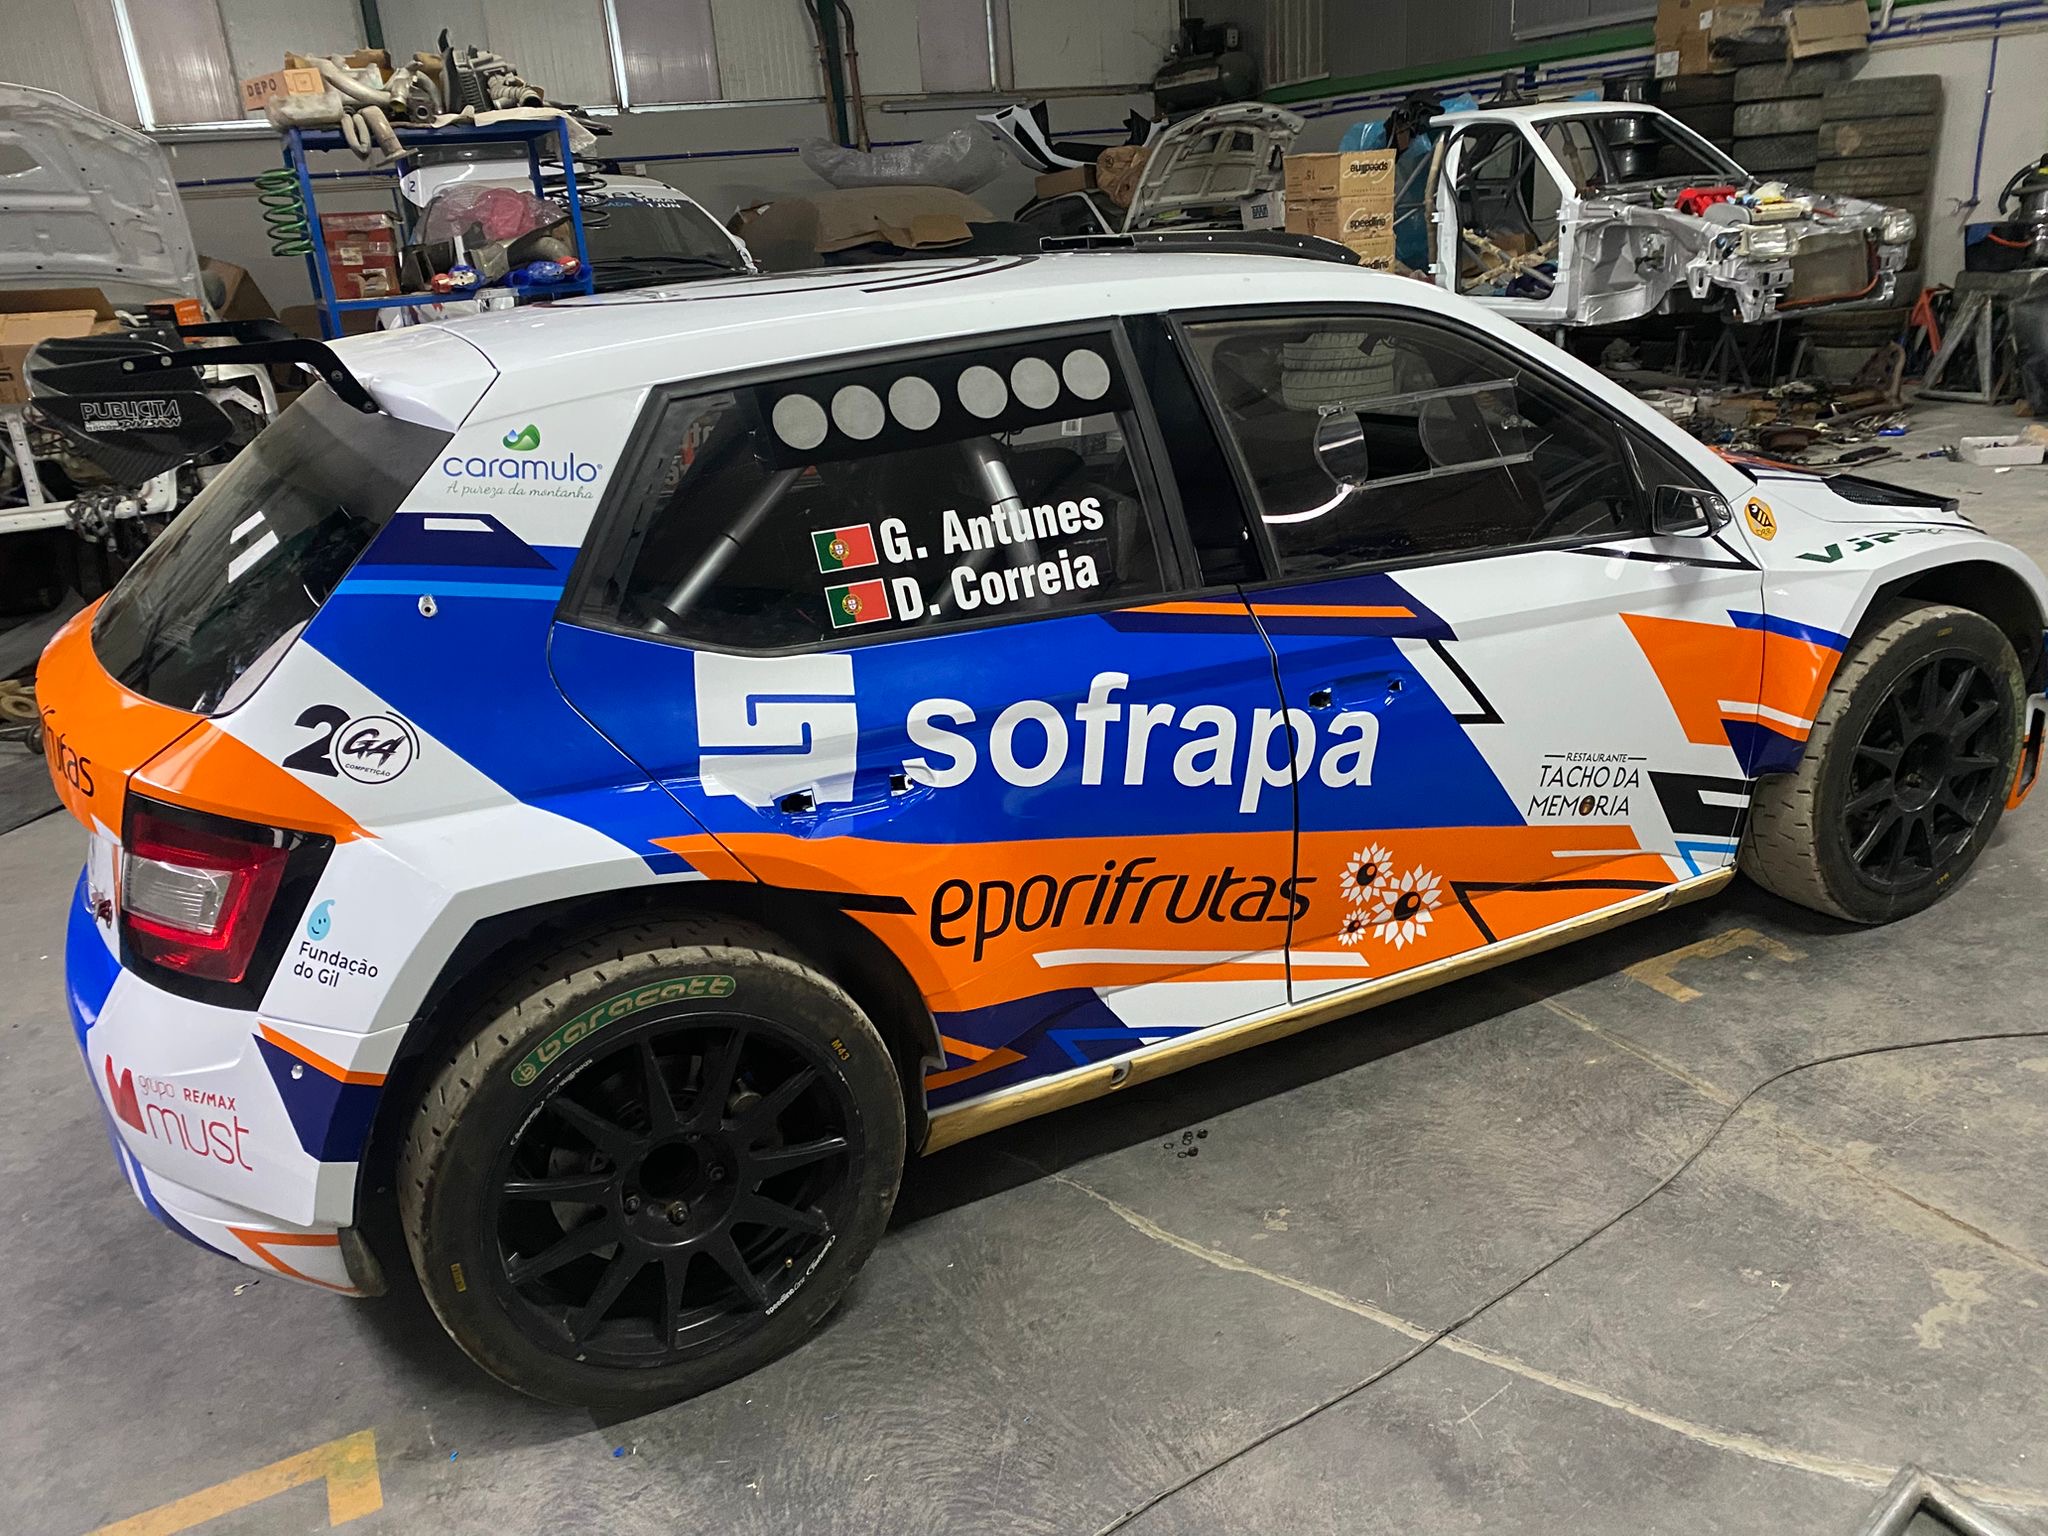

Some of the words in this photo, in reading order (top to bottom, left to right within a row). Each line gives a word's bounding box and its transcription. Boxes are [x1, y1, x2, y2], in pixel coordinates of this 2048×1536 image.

[246, 78, 277, 97] DEPO
[80, 399, 180, 420] PUBLICITA
[443, 452, 598, 483] caramulo
[461, 482, 505, 498] pureza
[508, 482, 526, 496] da
[529, 485, 594, 500] montanha
[879, 517, 929, 564] G.
[942, 496, 1104, 554] Antunes
[891, 576, 942, 621] D.
[951, 549, 1100, 611] Correia
[902, 671, 1380, 814] sofrapa
[1566, 752, 1628, 762] RESTAURANTE
[344, 763, 391, 778] COMPETIÇÃO
[1540, 765, 1611, 788] TACHO
[1612, 767, 1640, 788] DA
[929, 857, 1318, 962] eporifrutas
[299, 941, 378, 978] Fundação
[293, 961, 314, 979] do
[318, 968, 340, 988] Gil
[831, 1038, 850, 1061] M43
[138, 1075, 175, 1100] grupo
[183, 1088, 236, 1112] RE/MAX
[146, 1103, 253, 1172] must
